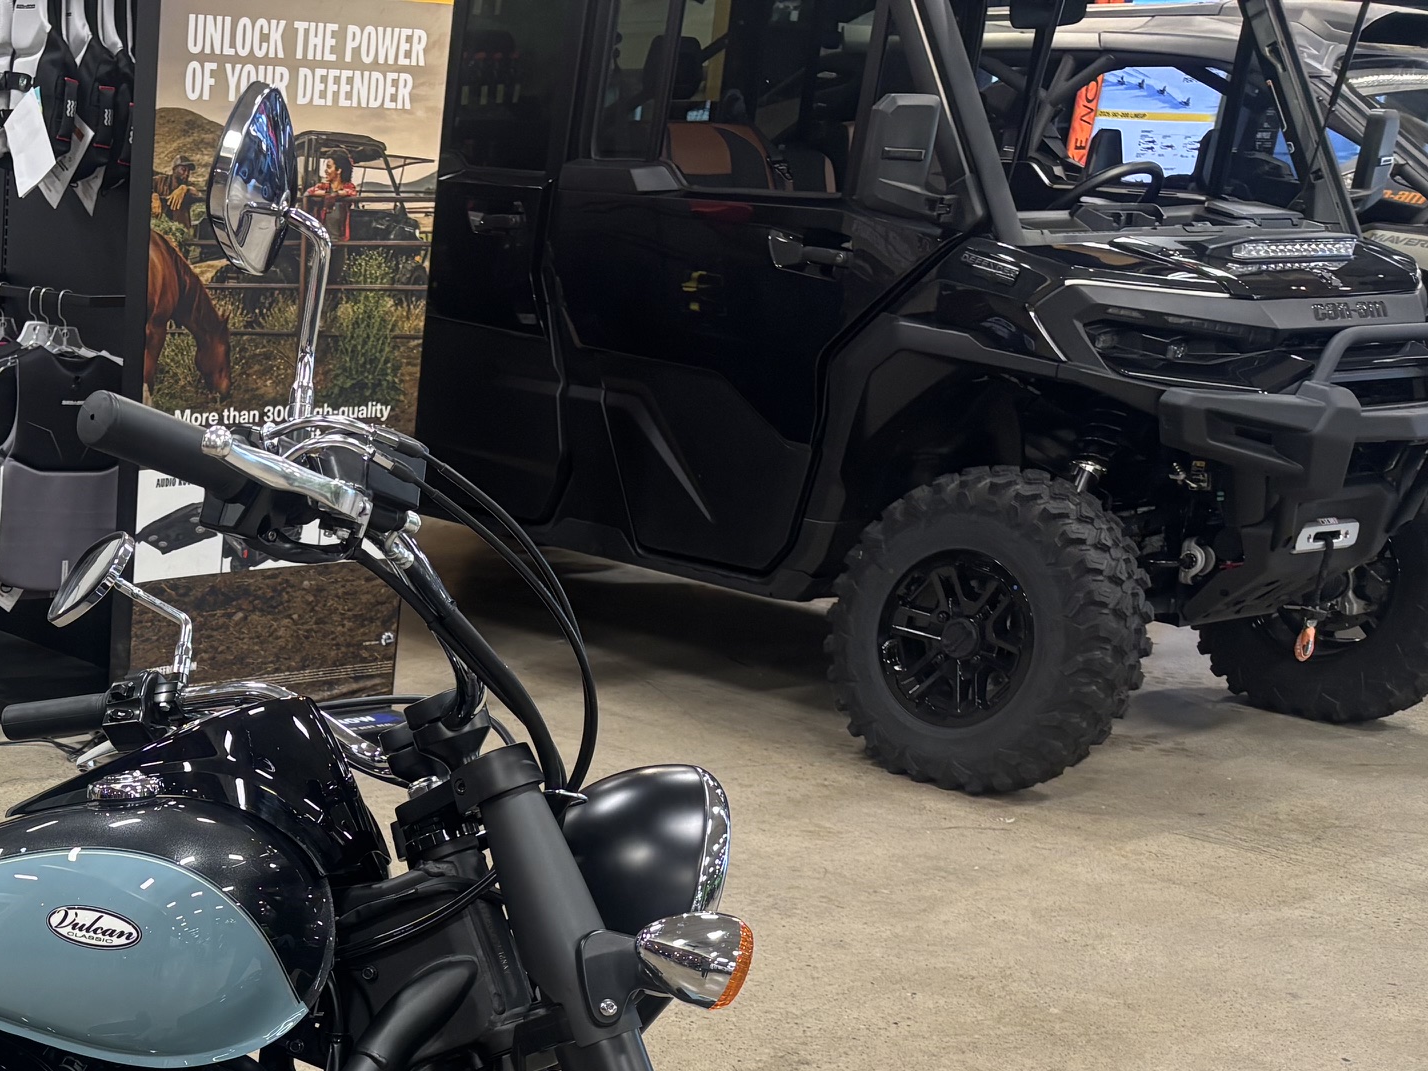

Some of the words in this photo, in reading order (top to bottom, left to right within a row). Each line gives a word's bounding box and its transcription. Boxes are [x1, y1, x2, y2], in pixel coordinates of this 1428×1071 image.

[187, 14, 287, 59] UNLOCK
[294, 21, 339, 61] THE
[344, 25, 428, 66] POWER
[185, 61, 218, 100] OF
[296, 67, 414, 110] DEFENDER
[1311, 300, 1388, 321] can-am
[174, 409, 219, 426] More
[222, 407, 259, 424] than
[155, 477, 177, 488] AUDIO
[54, 908, 135, 941] Vulcan
[66, 931, 114, 944] CLASSIC
